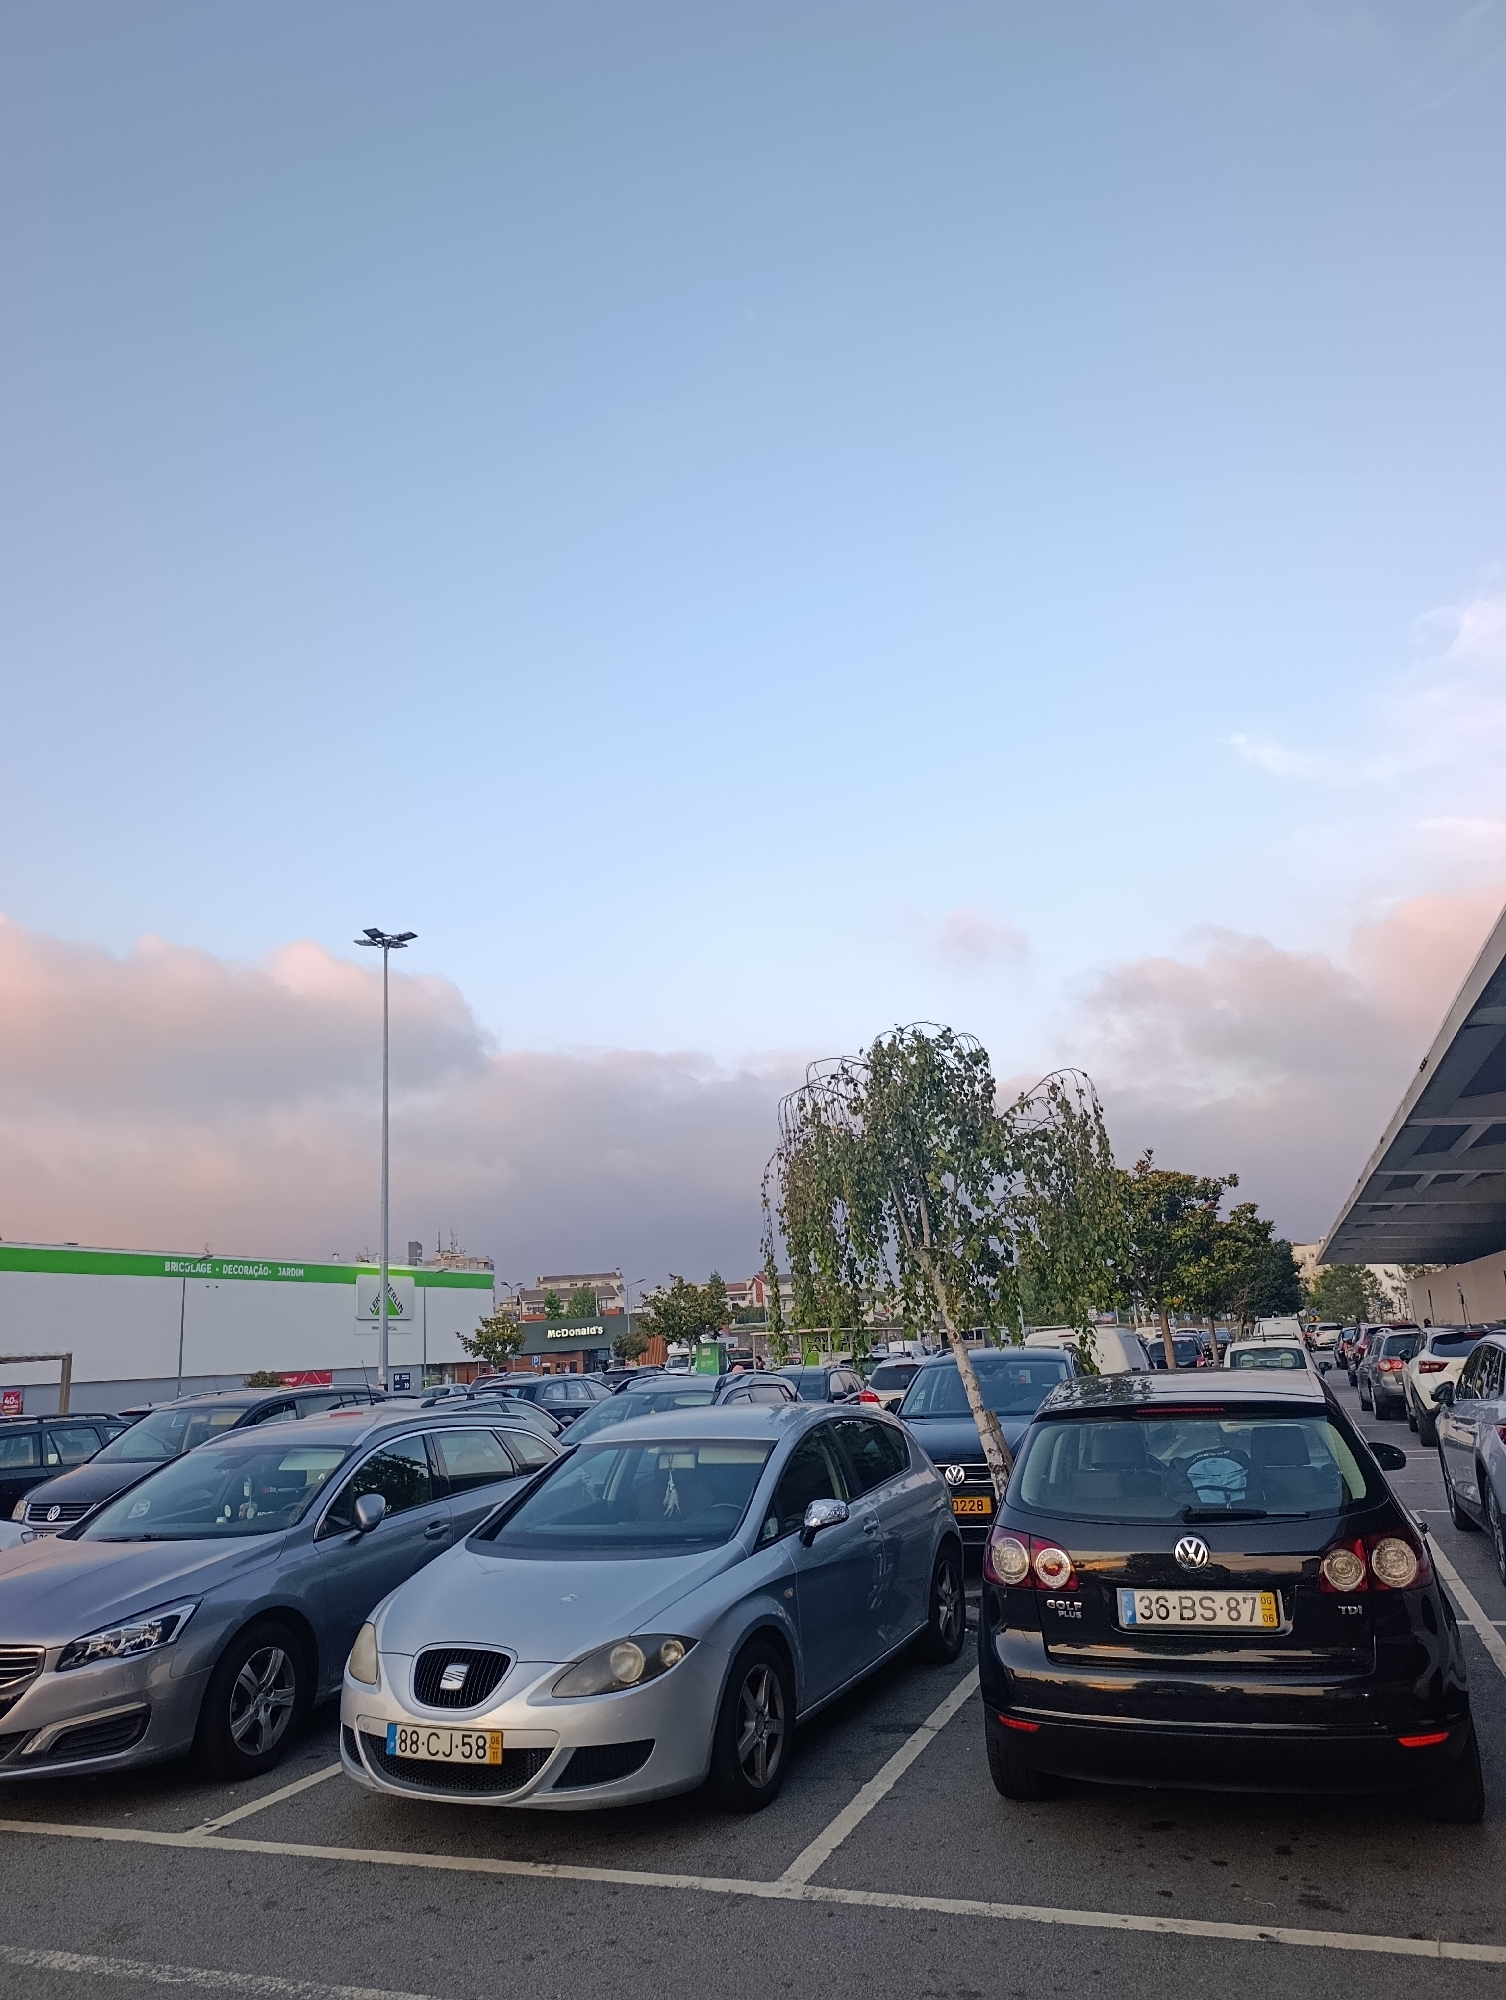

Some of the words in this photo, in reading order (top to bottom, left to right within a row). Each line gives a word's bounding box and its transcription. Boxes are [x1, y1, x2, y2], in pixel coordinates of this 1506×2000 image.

[164, 1261, 212, 1274] BRICOLAGE
[277, 1267, 304, 1277] JARDIM
[387, 1283, 404, 1314] ERLIN
[547, 1326, 603, 1338] McDonald's
[1046, 1599, 1082, 1611] GOLF
[1260, 1596, 1272, 1605] 06
[1057, 1610, 1082, 1619] PLUS
[1337, 1604, 1363, 1615] TDI
[1262, 1613, 1275, 1623] 06
[490, 1736, 500, 1745] 06
[492, 1750, 498, 1760] 11
